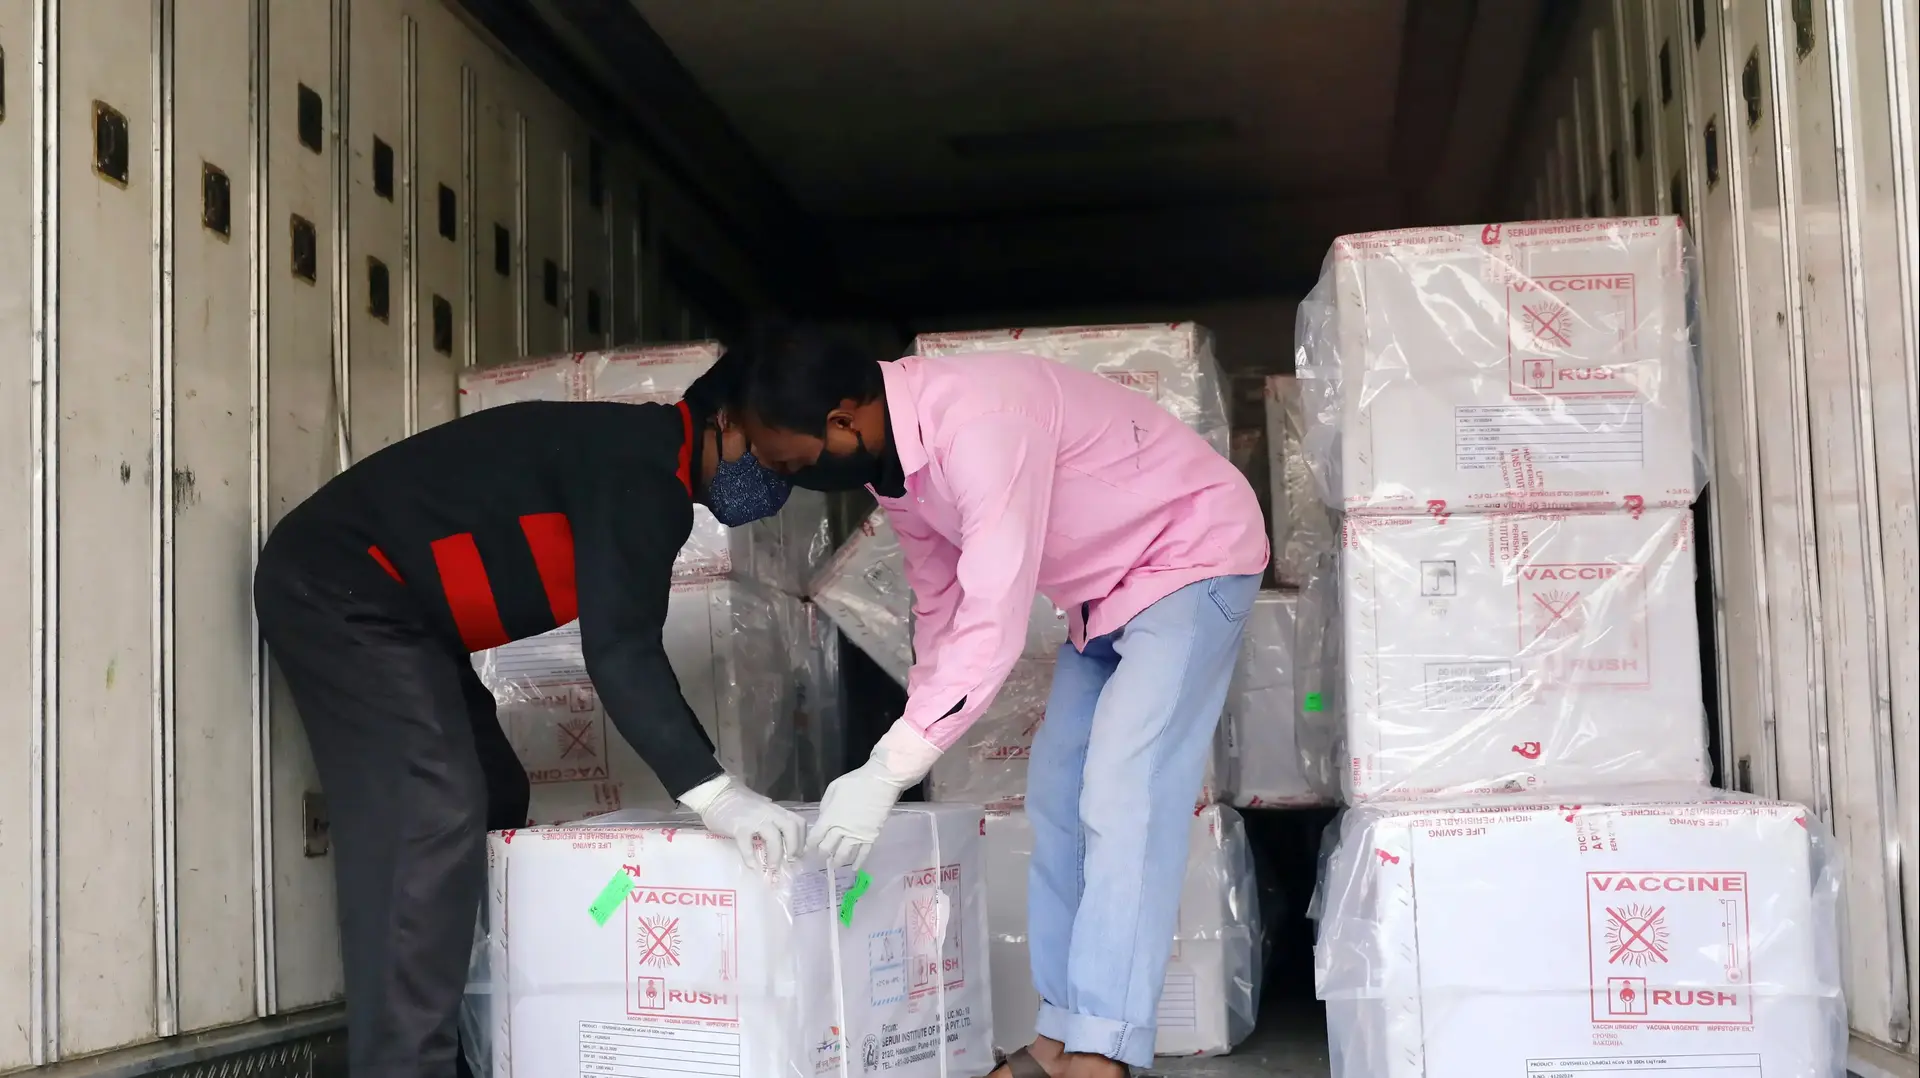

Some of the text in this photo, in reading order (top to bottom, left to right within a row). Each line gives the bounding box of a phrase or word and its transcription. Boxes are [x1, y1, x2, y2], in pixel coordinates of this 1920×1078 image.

[1508, 227, 1537, 238] SERUM
[1539, 224, 1582, 235] INSTITUTE
[1584, 223, 1594, 232] OF
[1512, 277, 1632, 293] VACCINE
[1559, 367, 1622, 381] RUS
[1511, 454, 1525, 489] INSTITUT
[1512, 523, 1520, 558] PERISHA
[1524, 567, 1620, 581] VACCIN
[1572, 657, 1638, 671] RUSH
[530, 766, 605, 780] VACCIN
[1353, 757, 1361, 787] SERUM
[1436, 816, 1495, 826] PERISHABLE
[1499, 815, 1532, 824] HIGHLY
[1669, 818, 1729, 827] LIFE SAVING
[541, 833, 577, 841] MEDICINES
[578, 833, 618, 841] PERISHABLE
[1428, 827, 1486, 838] LIFE SAVING
[572, 842, 597, 850] SAVING
[1592, 877, 1743, 893] VACCINE
[630, 890, 733, 907] VACCINE
[929, 957, 959, 975] RSH
[668, 989, 728, 1005] RUSH
[1653, 990, 1737, 1006] RUSH
[882, 1034, 901, 1047] SERUM
[901, 1027, 927, 1042] INSTITUTE
[928, 1025, 935, 1036] OF
